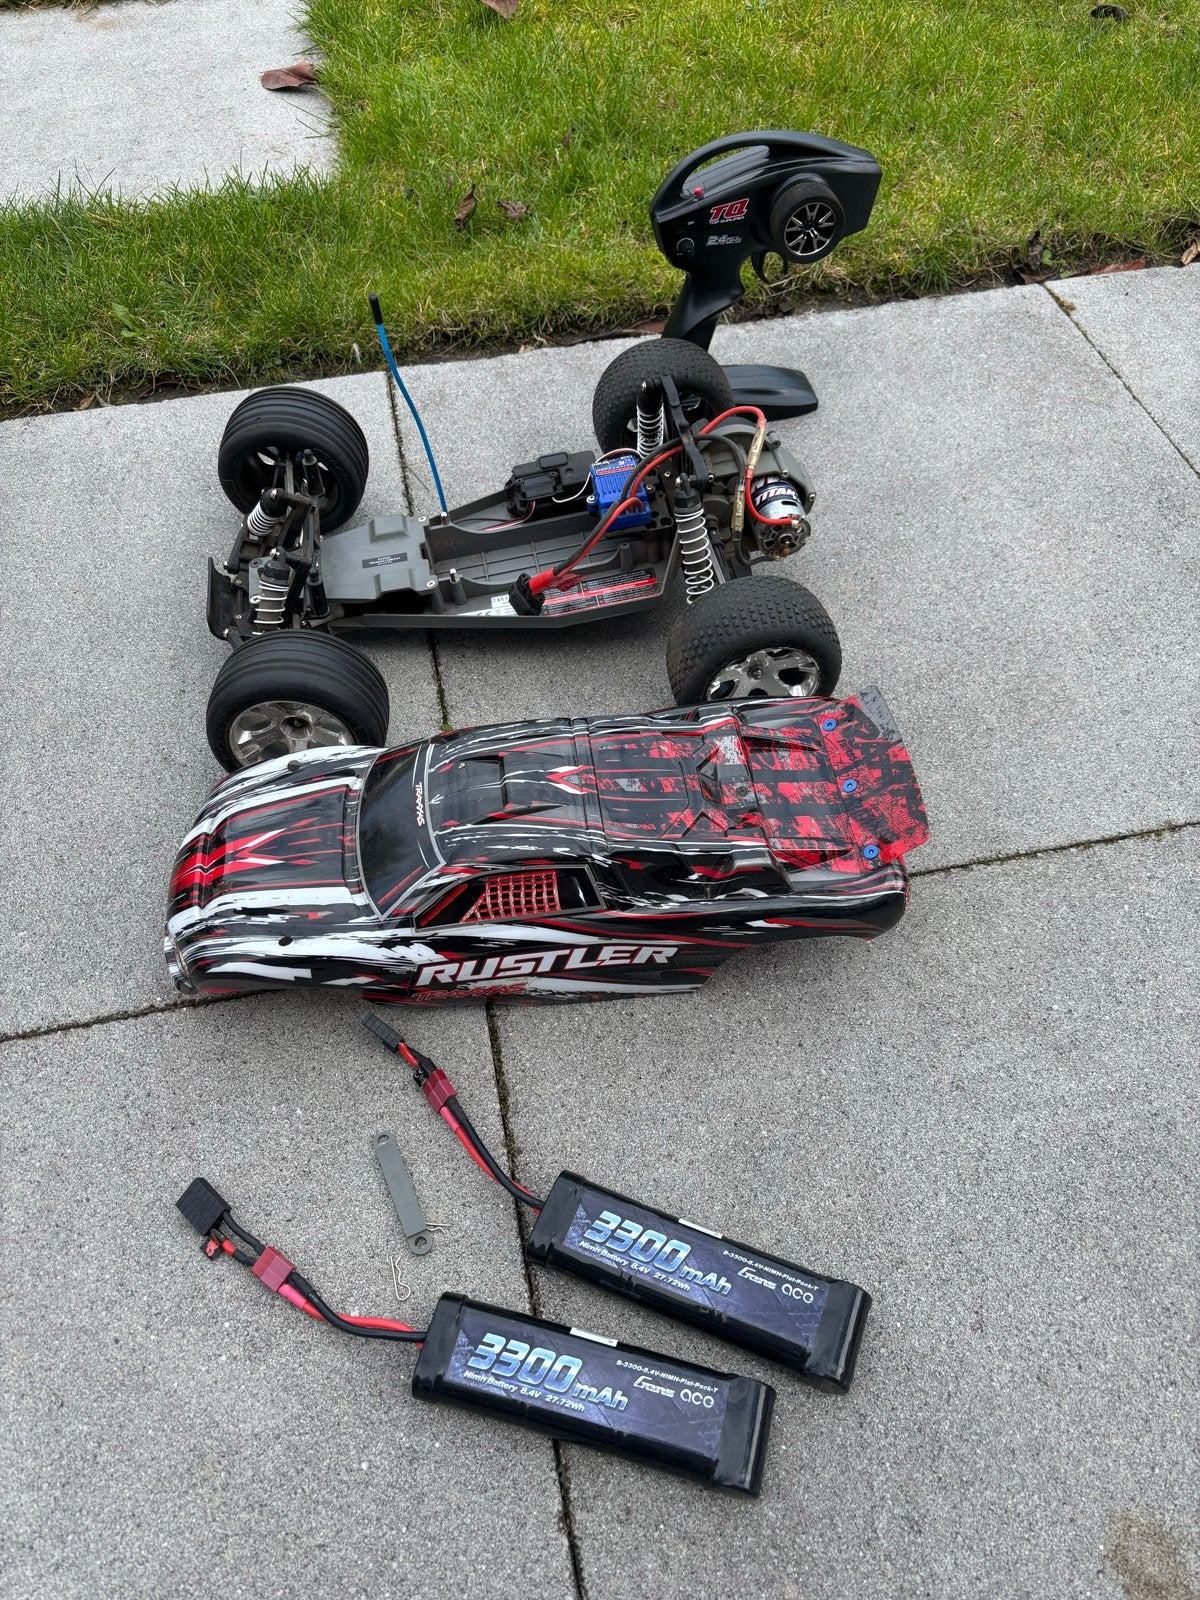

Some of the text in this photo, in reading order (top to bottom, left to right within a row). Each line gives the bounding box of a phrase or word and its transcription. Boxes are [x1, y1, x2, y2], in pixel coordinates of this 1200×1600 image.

[709, 198, 750, 222] TQ
[415, 782, 425, 826] TRAXXAS
[415, 945, 679, 986] RUSTLER
[411, 981, 529, 1001] TRAXXAS
[583, 1210, 732, 1295] 3300 mAh
[600, 1249, 629, 1267] Battery
[630, 1262, 651, 1275] 8.4V
[653, 1271, 691, 1291] 27.72Wh
[737, 1266, 777, 1290] Gens
[467, 1332, 629, 1411] 3300 mAh
[633, 1375, 676, 1397] Gens
[487, 1377, 518, 1393] Battery
[520, 1386, 541, 1399] 8.4V
[544, 1394, 585, 1412] 27.72Wh
